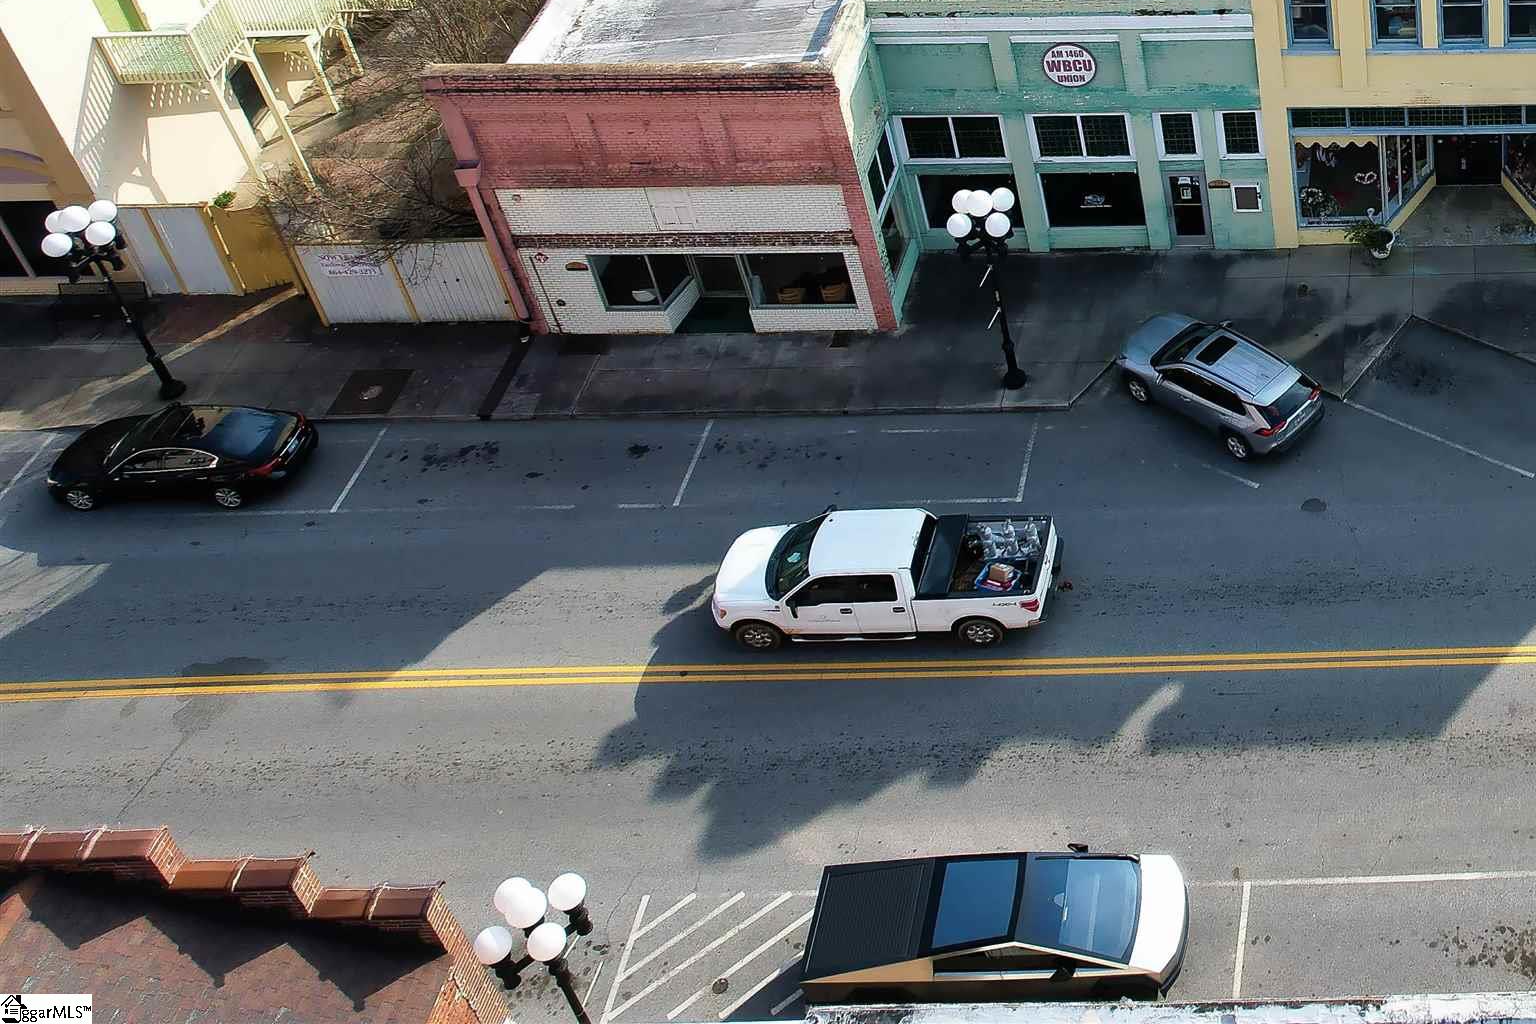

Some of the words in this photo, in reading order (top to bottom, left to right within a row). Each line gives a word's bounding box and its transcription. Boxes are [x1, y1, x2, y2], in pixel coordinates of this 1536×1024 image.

[1051, 50, 1063, 58] AM
[1045, 59, 1093, 72] WBCU
[1057, 74, 1086, 83] UNION
